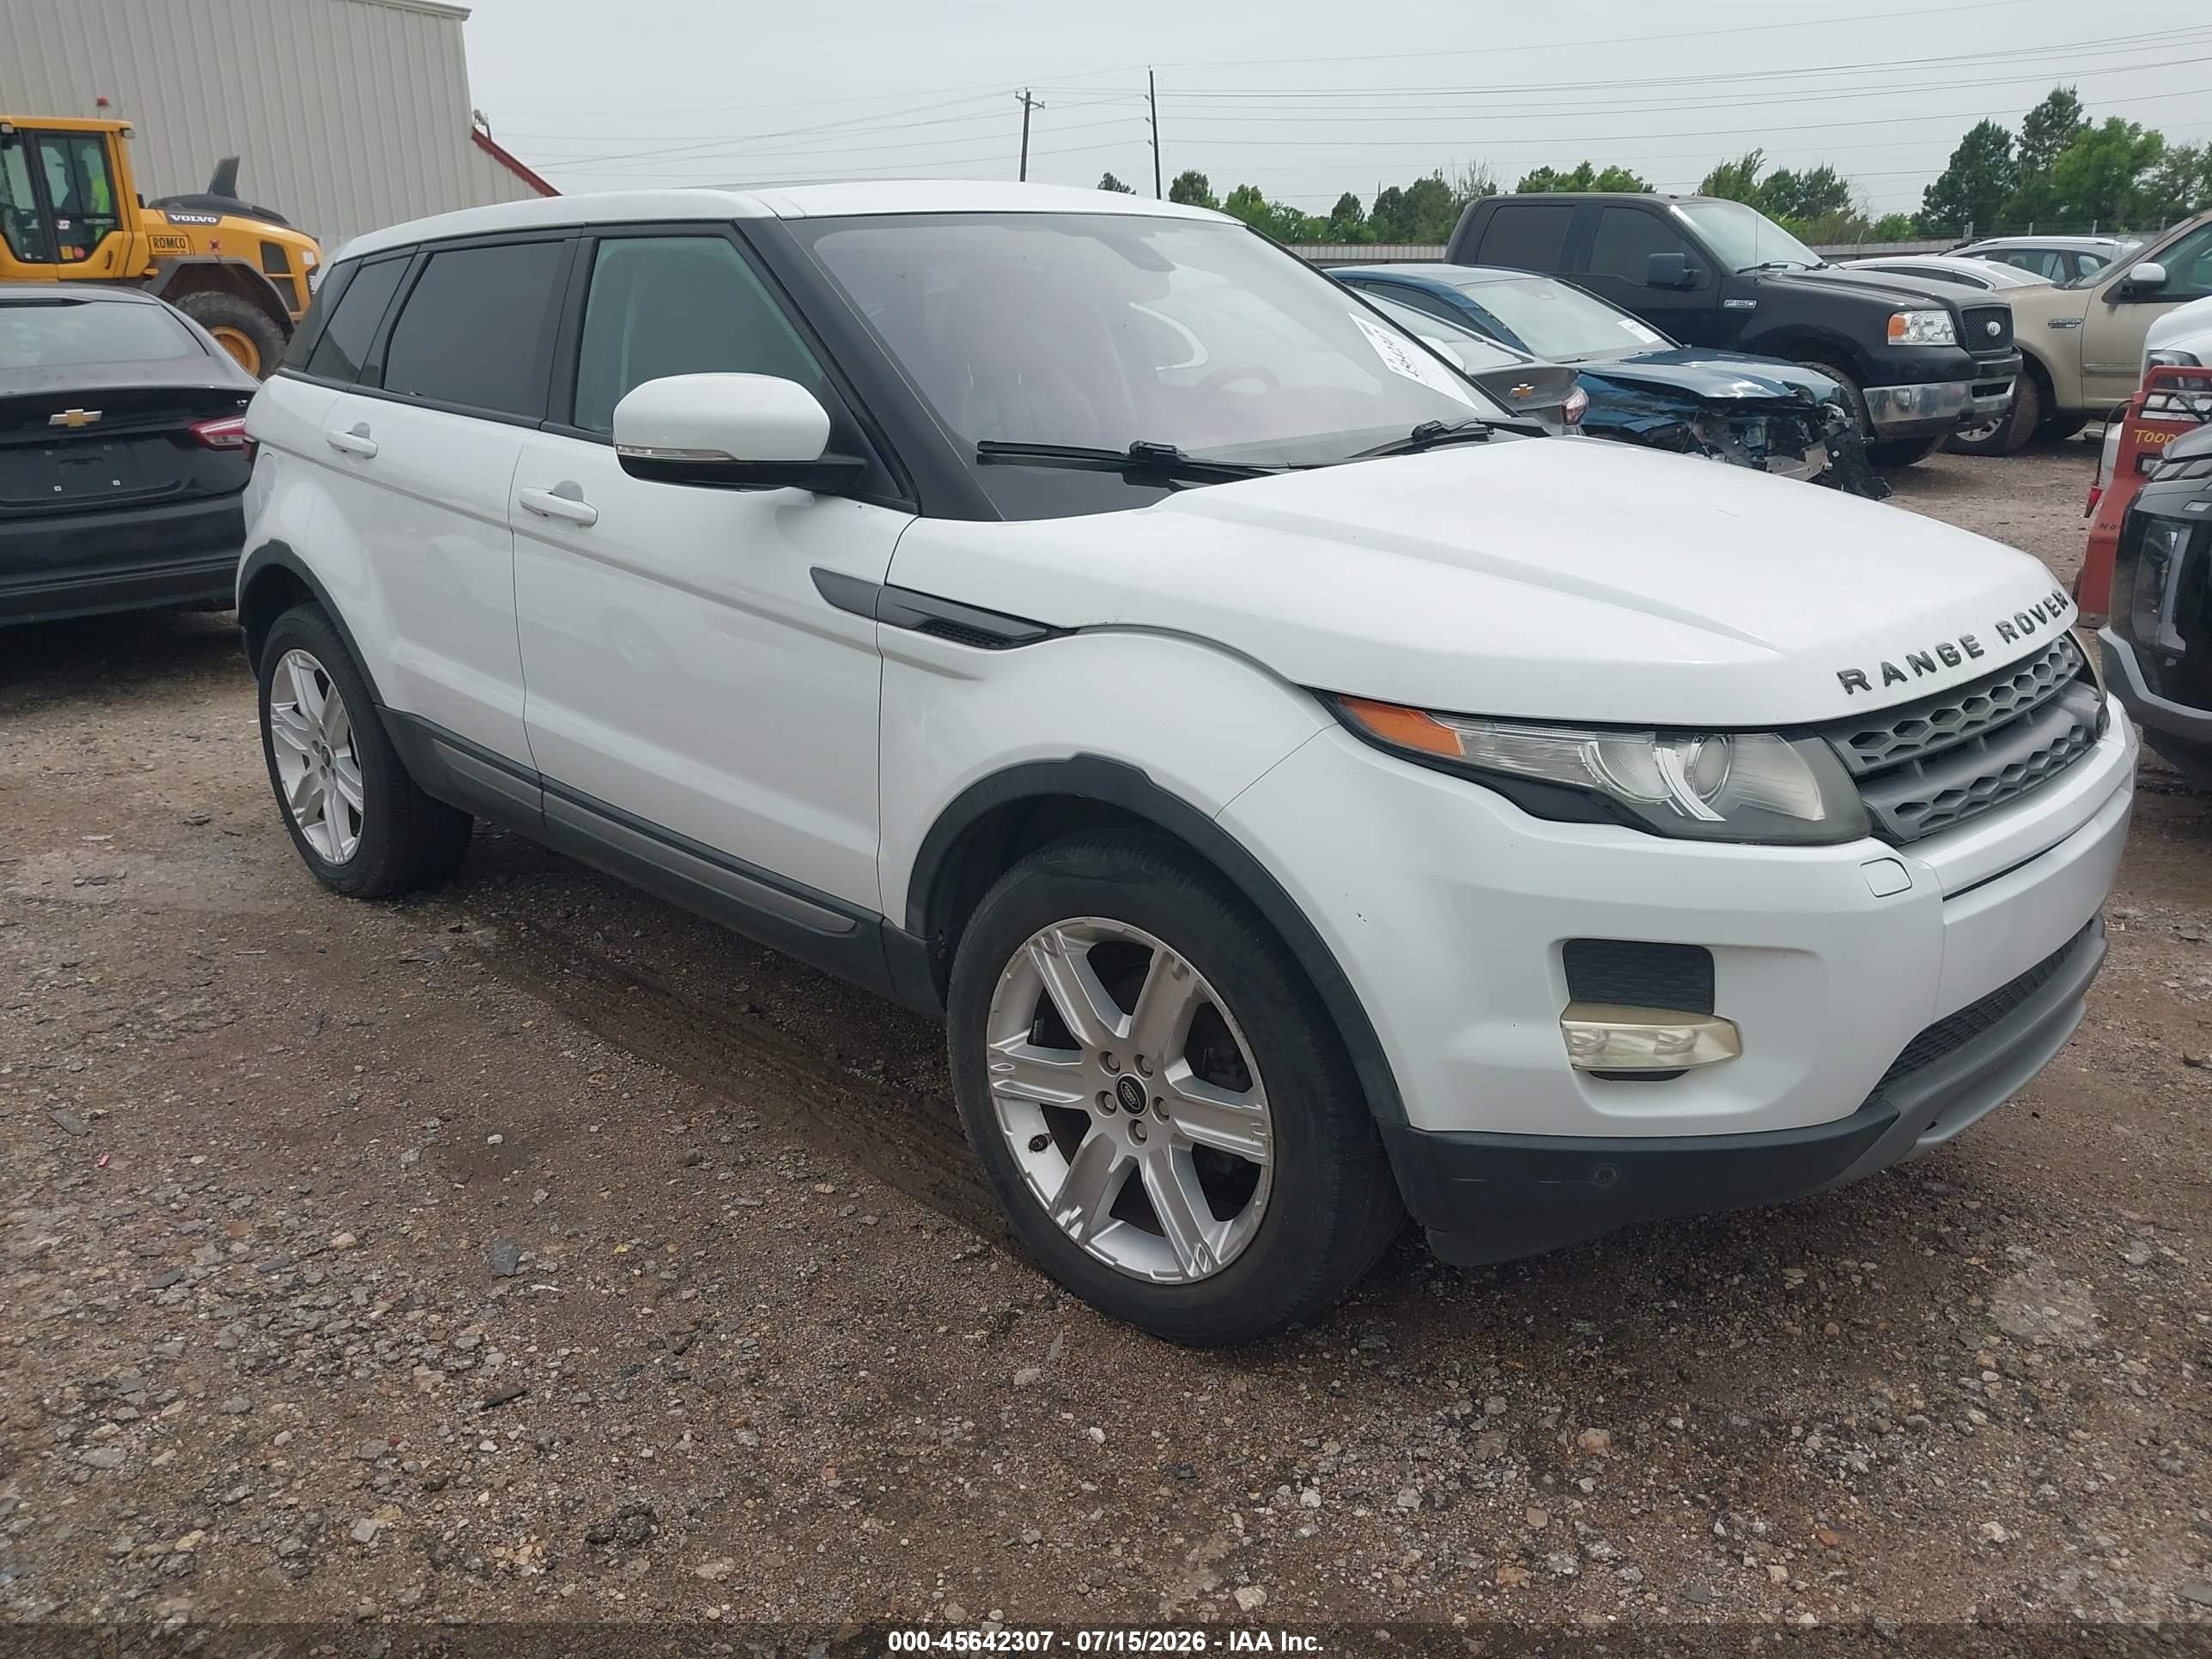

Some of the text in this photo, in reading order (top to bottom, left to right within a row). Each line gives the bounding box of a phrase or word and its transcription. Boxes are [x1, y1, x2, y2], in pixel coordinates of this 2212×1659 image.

[170, 215, 218, 223] VOLVO
[153, 237, 186, 249] ROMCO
[1836, 588, 2069, 695] RANGE ROVER
